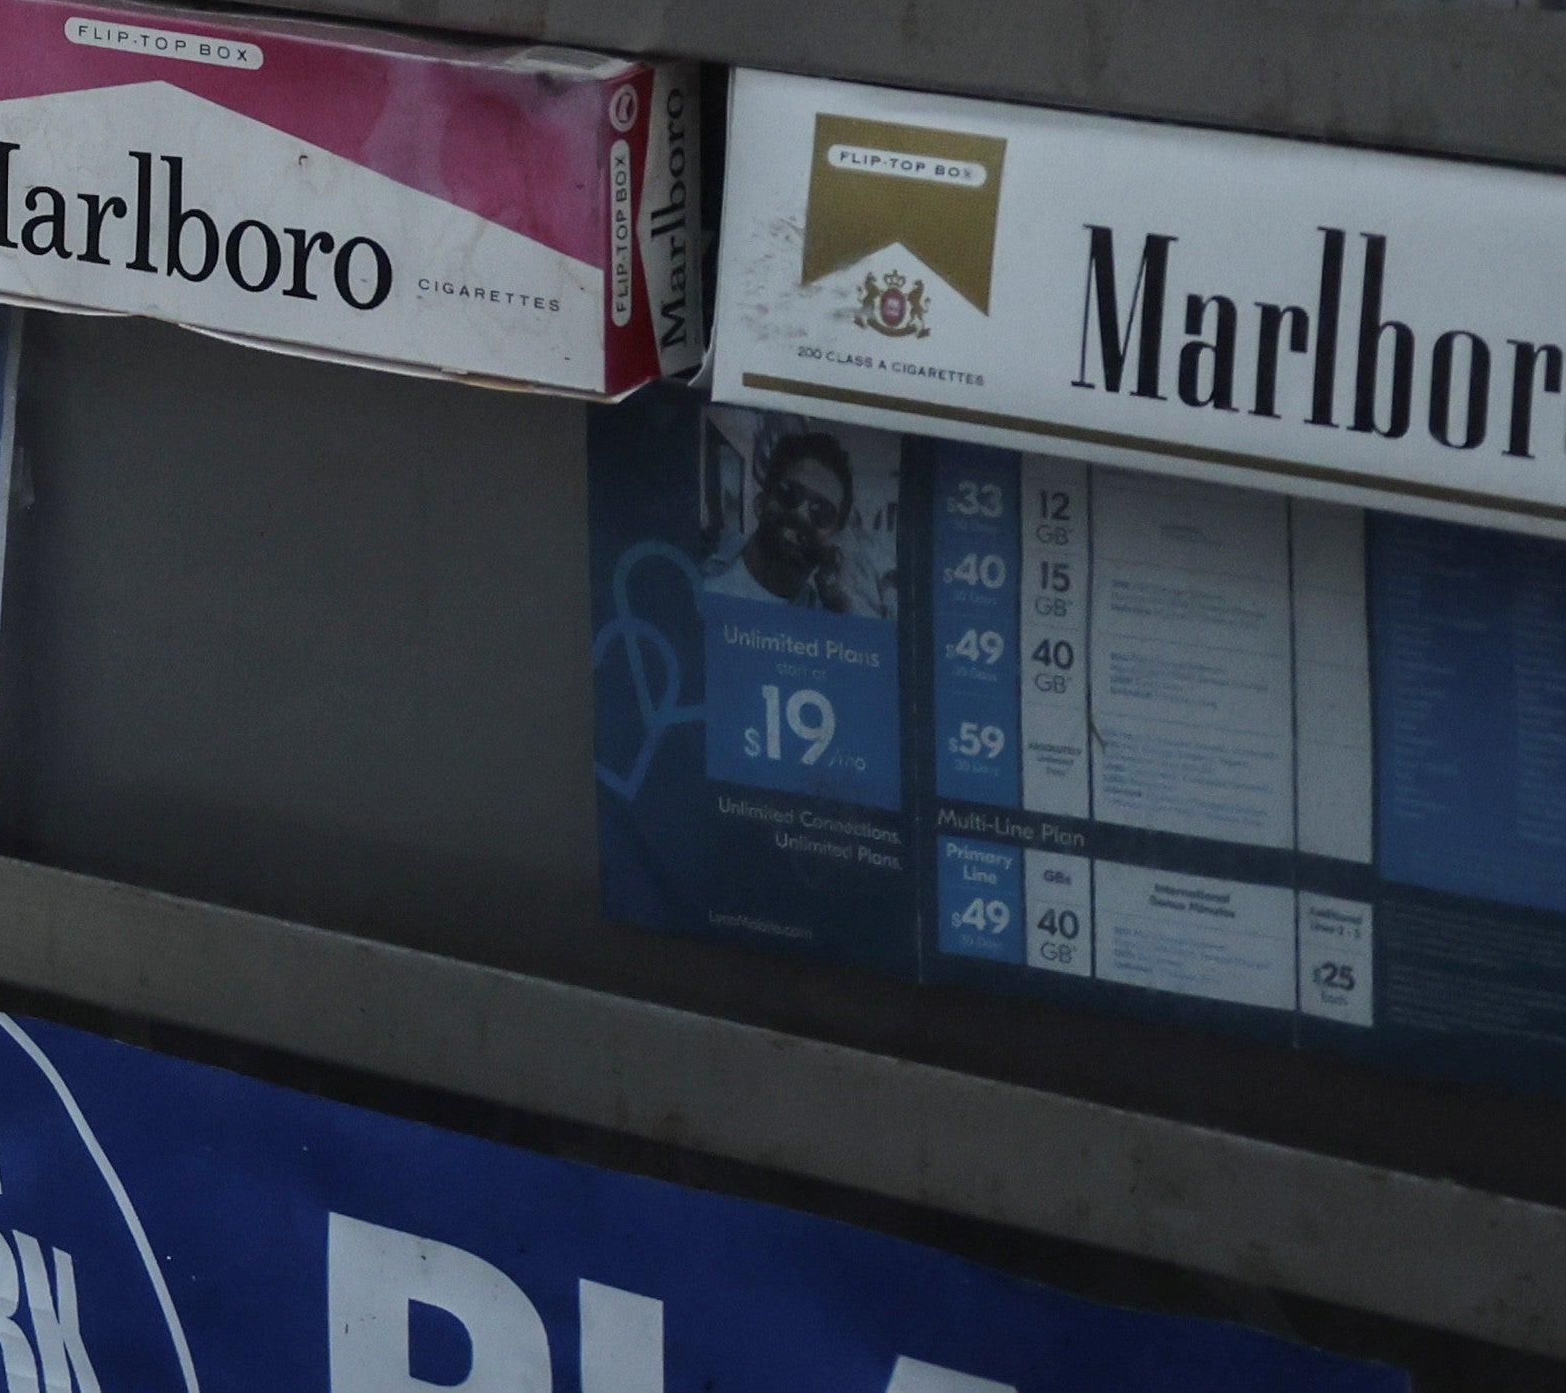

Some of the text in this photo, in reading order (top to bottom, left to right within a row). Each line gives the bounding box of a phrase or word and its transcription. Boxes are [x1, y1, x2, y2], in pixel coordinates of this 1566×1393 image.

[77, 24, 251, 64] FLIP-TOP BOX
[839, 150, 926, 173] FLIP-TOP
[615, 155, 629, 314] FLIP-TOP BOX
[651, 87, 688, 351] Marlboro
[417, 277, 562, 314] CIGARETTES
[1071, 222, 1566, 462] Marlbor
[825, 350, 873, 370] CLASS
[877, 358, 888, 371] A
[890, 360, 986, 388] CIGARETTES
[1038, 489, 1070, 522] 12
[1040, 560, 1071, 594] 15
[722, 623, 881, 669] Unlimited Plans
[1031, 638, 1075, 672] 40
[937, 807, 1087, 848] Multi-Line Plan
[1037, 908, 1081, 941] 40
